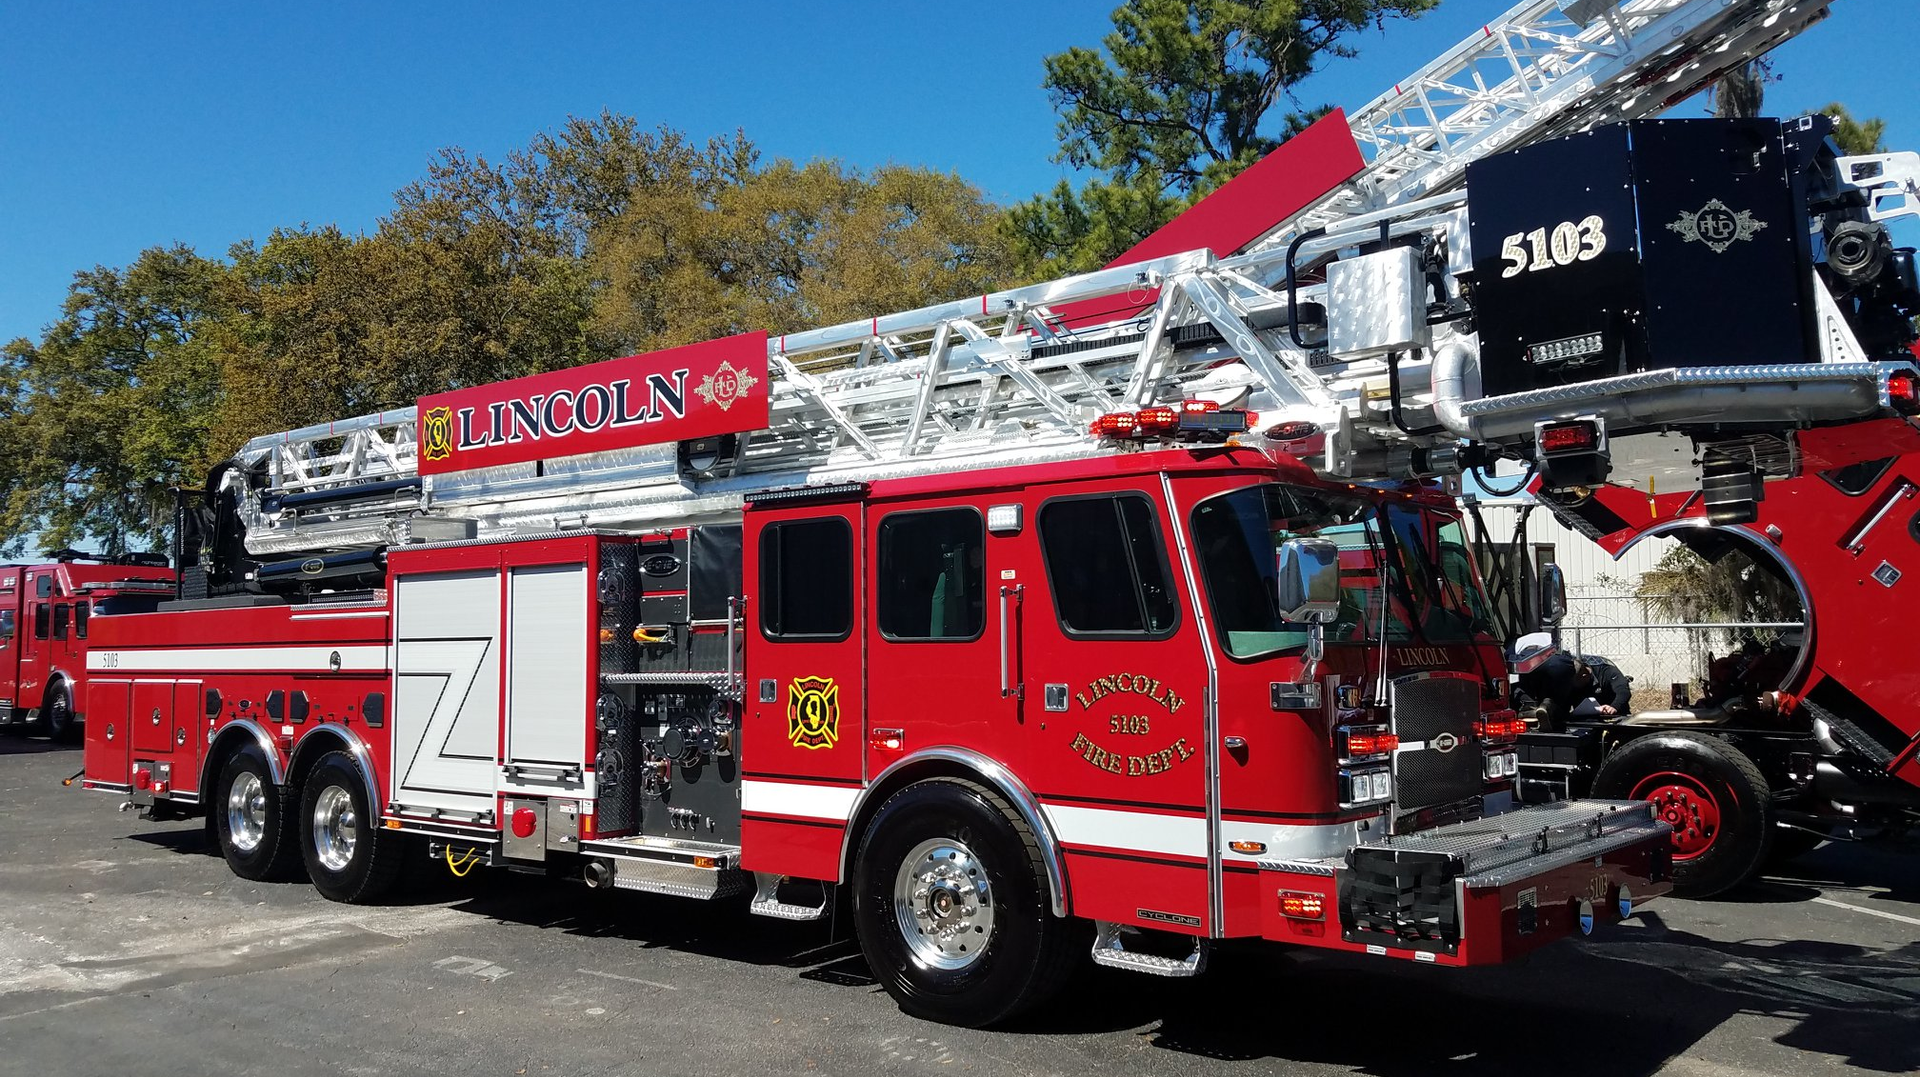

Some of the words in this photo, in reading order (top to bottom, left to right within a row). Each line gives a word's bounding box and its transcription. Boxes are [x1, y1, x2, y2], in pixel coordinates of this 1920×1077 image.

[1501, 215, 1606, 278] 5103
[458, 368, 688, 451] LINCOLN
[102, 653, 119, 668] 5103
[1396, 647, 1451, 666] LINCOLN
[801, 681, 826, 691] LINCOLN
[1075, 672, 1186, 714] LINCOLN
[1109, 714, 1150, 735] 5103
[1069, 732, 1122, 775] FIRE
[1127, 737, 1196, 777] DEPT.
[1589, 873, 1609, 901] 5103
[1138, 910, 1199, 925] CYCLONE
